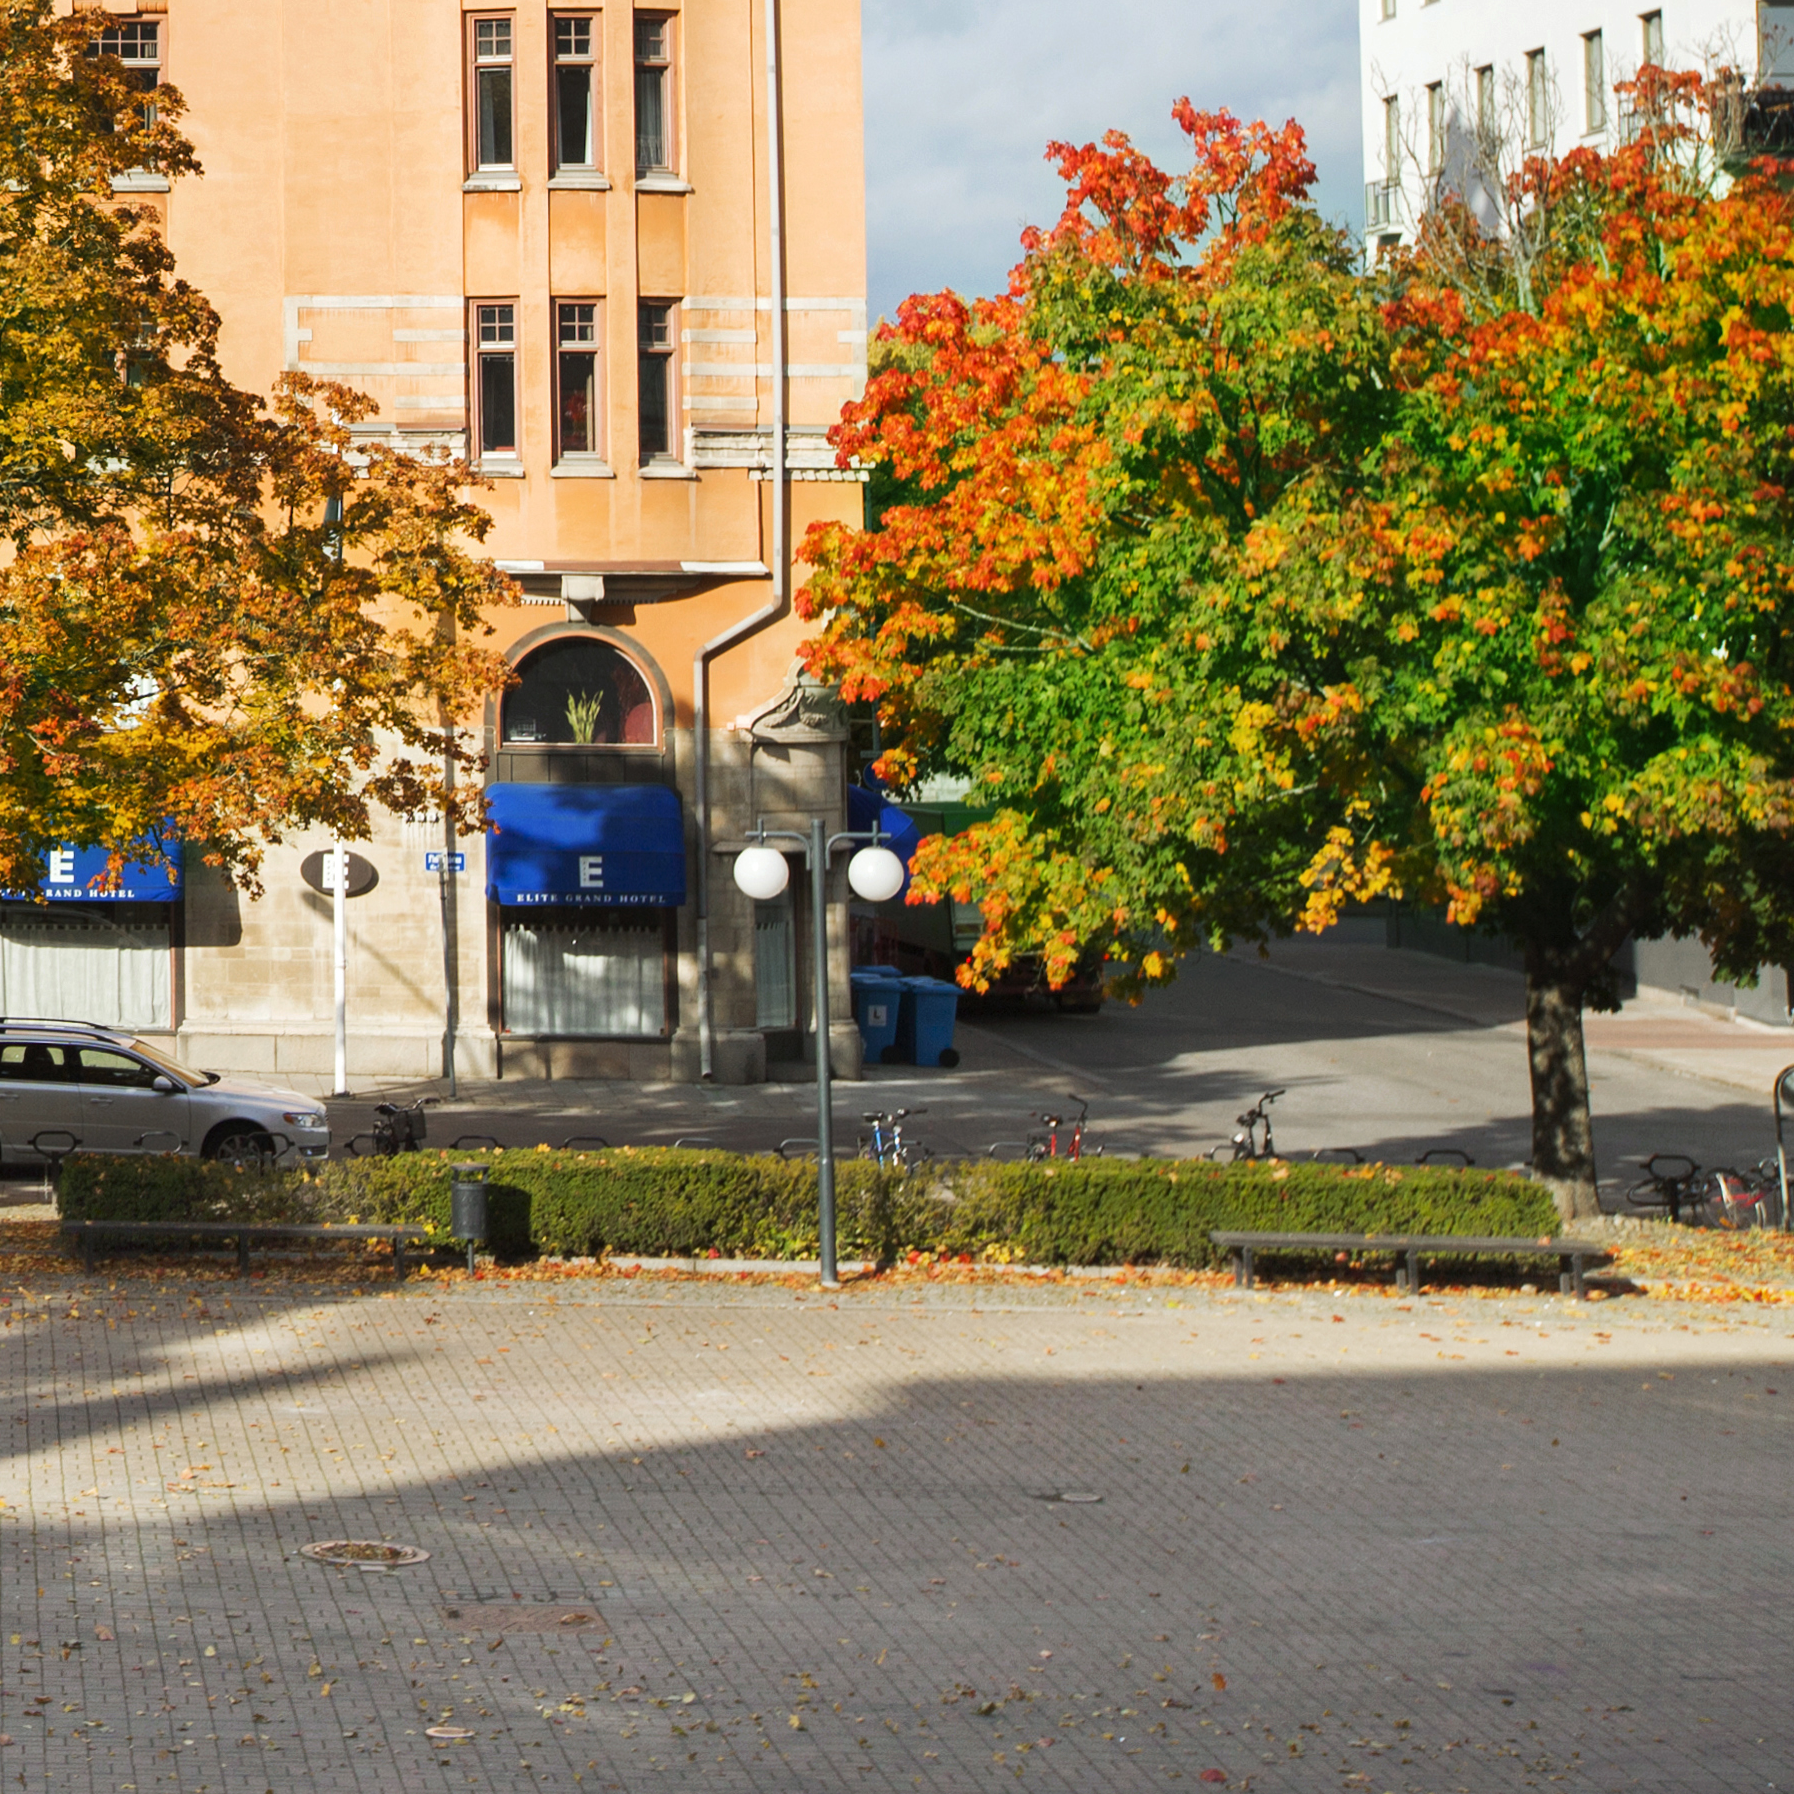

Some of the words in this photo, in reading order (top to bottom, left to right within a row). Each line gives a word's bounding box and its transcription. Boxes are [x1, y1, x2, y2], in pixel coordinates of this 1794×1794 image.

[49, 851, 75, 883] E
[579, 856, 604, 888] E
[42, 889, 82, 898] RAND
[89, 889, 135, 898] HOTEL
[516, 893, 558, 903] ELITE
[565, 893, 612, 903] GRAND
[619, 895, 666, 903] HOTEL
